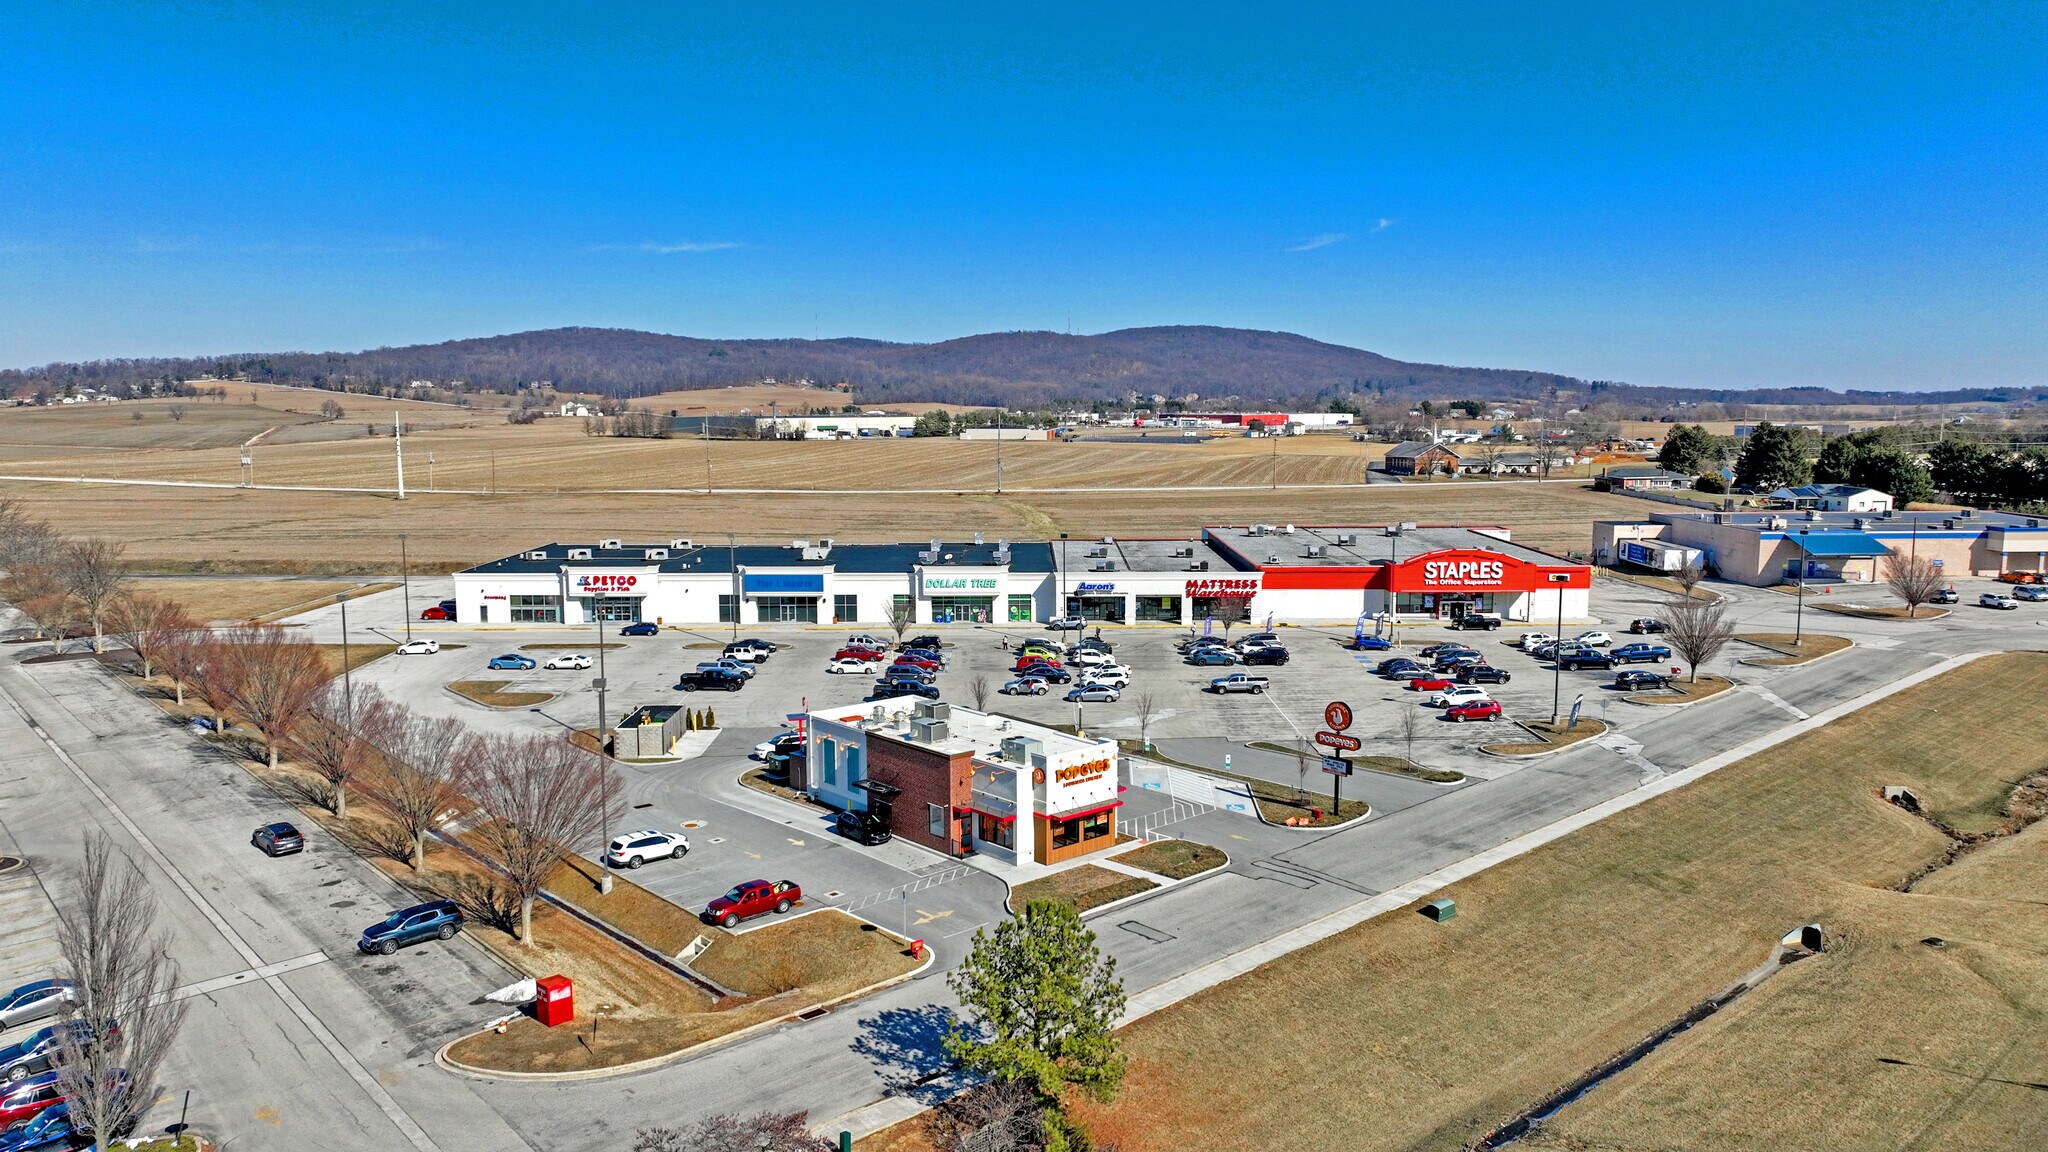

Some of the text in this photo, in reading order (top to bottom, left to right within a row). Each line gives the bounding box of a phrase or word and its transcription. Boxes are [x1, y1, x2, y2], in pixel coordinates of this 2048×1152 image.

[1424, 561, 1504, 579] STAPLES
[592, 575, 637, 587] PETCO
[925, 578, 997, 588] DOLLAR TREE
[1079, 581, 1115, 591] Aaron's
[1185, 579, 1258, 590] MATTRESS
[1463, 579, 1502, 587] Superstore
[1185, 588, 1258, 599] Warehouse
[1319, 734, 1354, 748] POPEYES
[1055, 758, 1110, 783] POPEYES
